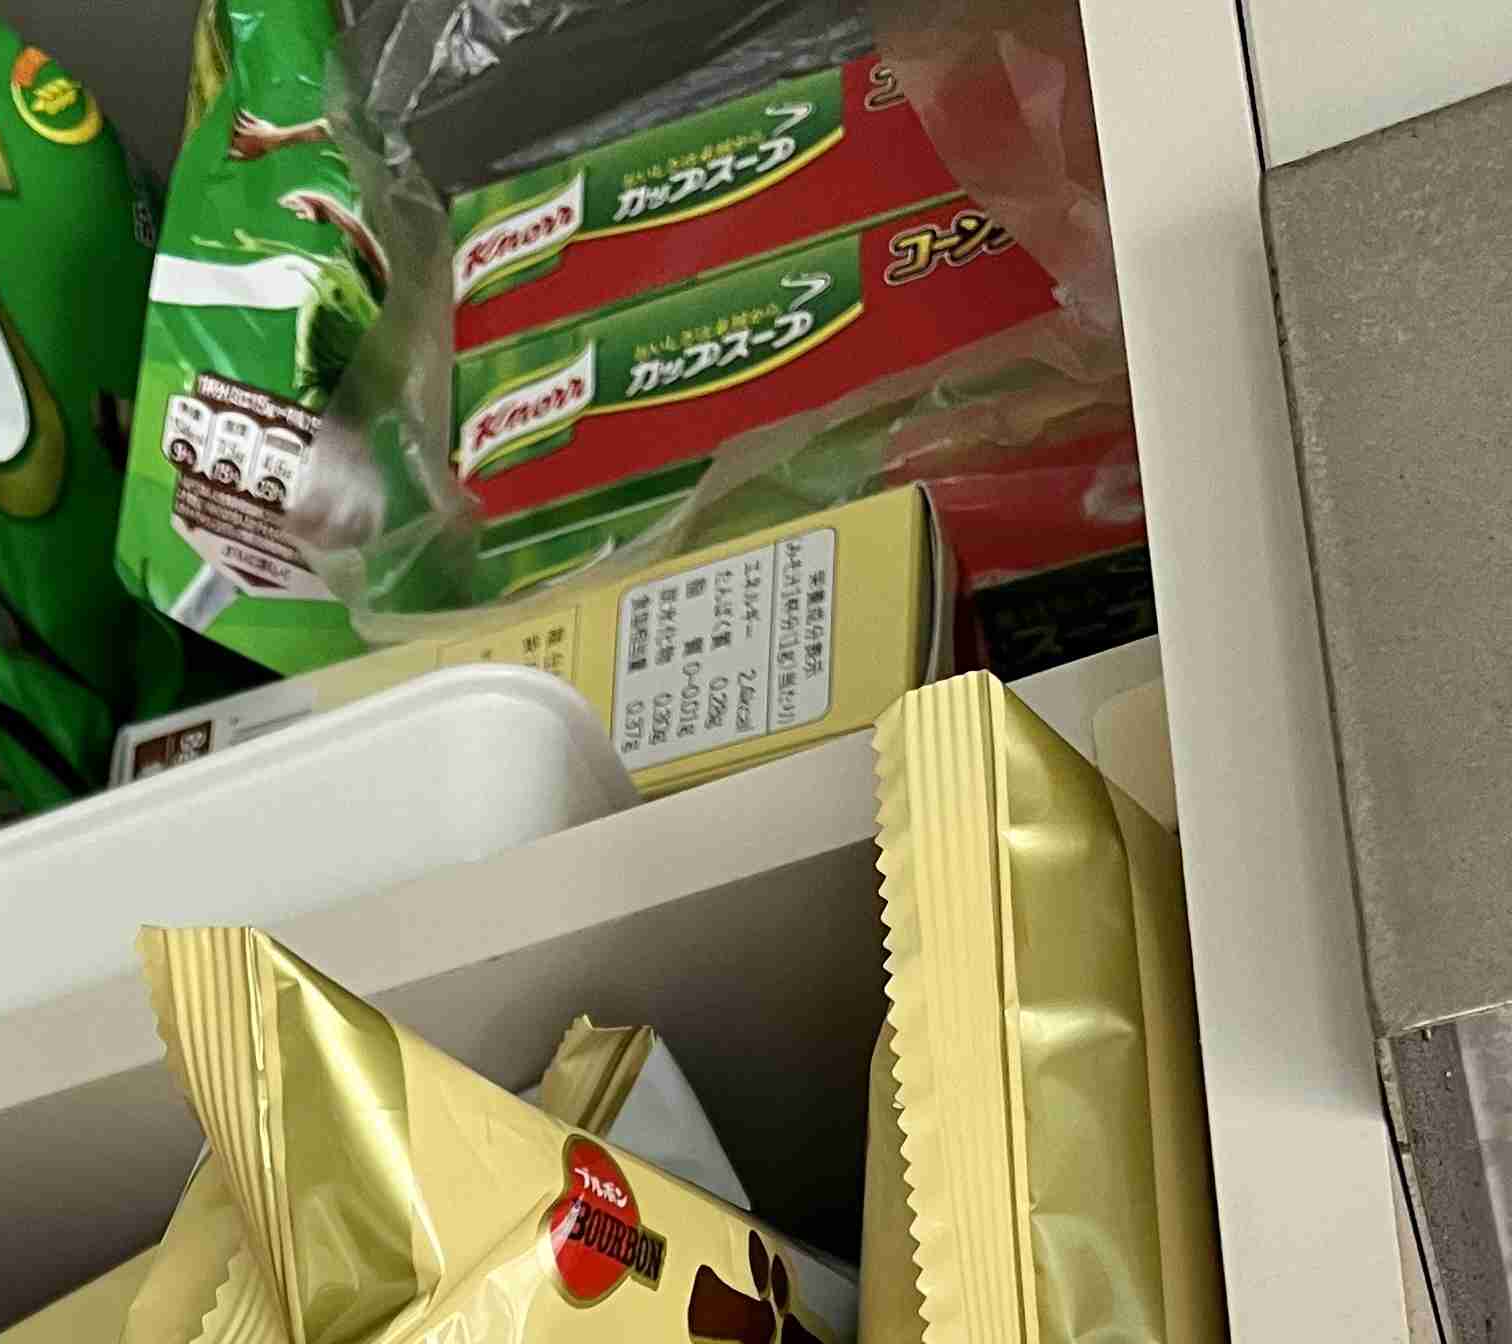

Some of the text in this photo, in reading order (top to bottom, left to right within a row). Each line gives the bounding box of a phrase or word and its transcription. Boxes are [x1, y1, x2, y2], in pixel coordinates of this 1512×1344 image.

[462, 202, 575, 277] Knorr
[472, 377, 586, 444] Knorr
[575, 1166, 628, 1206] ブルボン
[570, 1199, 666, 1282] BOURBON
